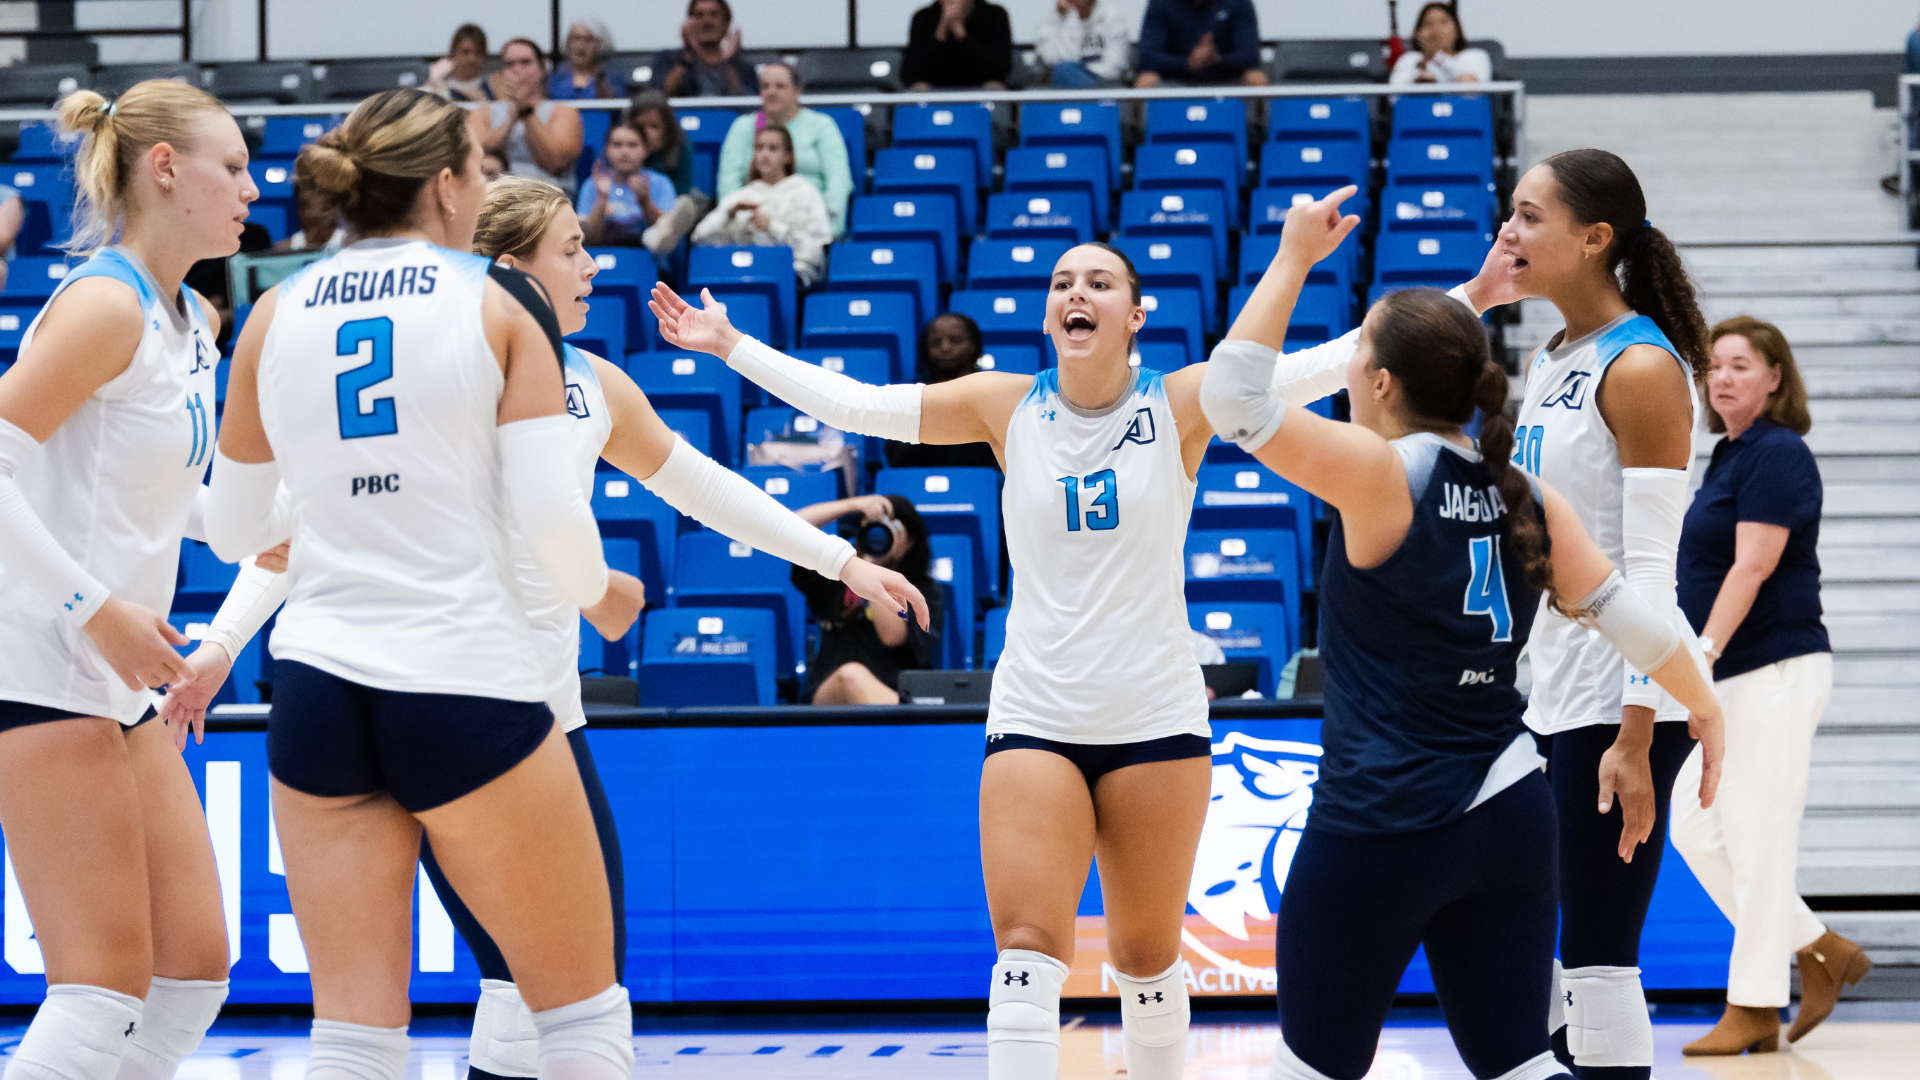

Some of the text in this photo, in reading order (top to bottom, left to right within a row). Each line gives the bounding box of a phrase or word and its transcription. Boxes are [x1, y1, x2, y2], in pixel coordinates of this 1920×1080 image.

[305, 266, 438, 308] JAGUARS
[336, 316, 398, 440] 2
[186, 392, 208, 467] 11
[351, 473, 400, 497] PBC
[1056, 468, 1119, 531] 13
[1463, 534, 1513, 643] 4
